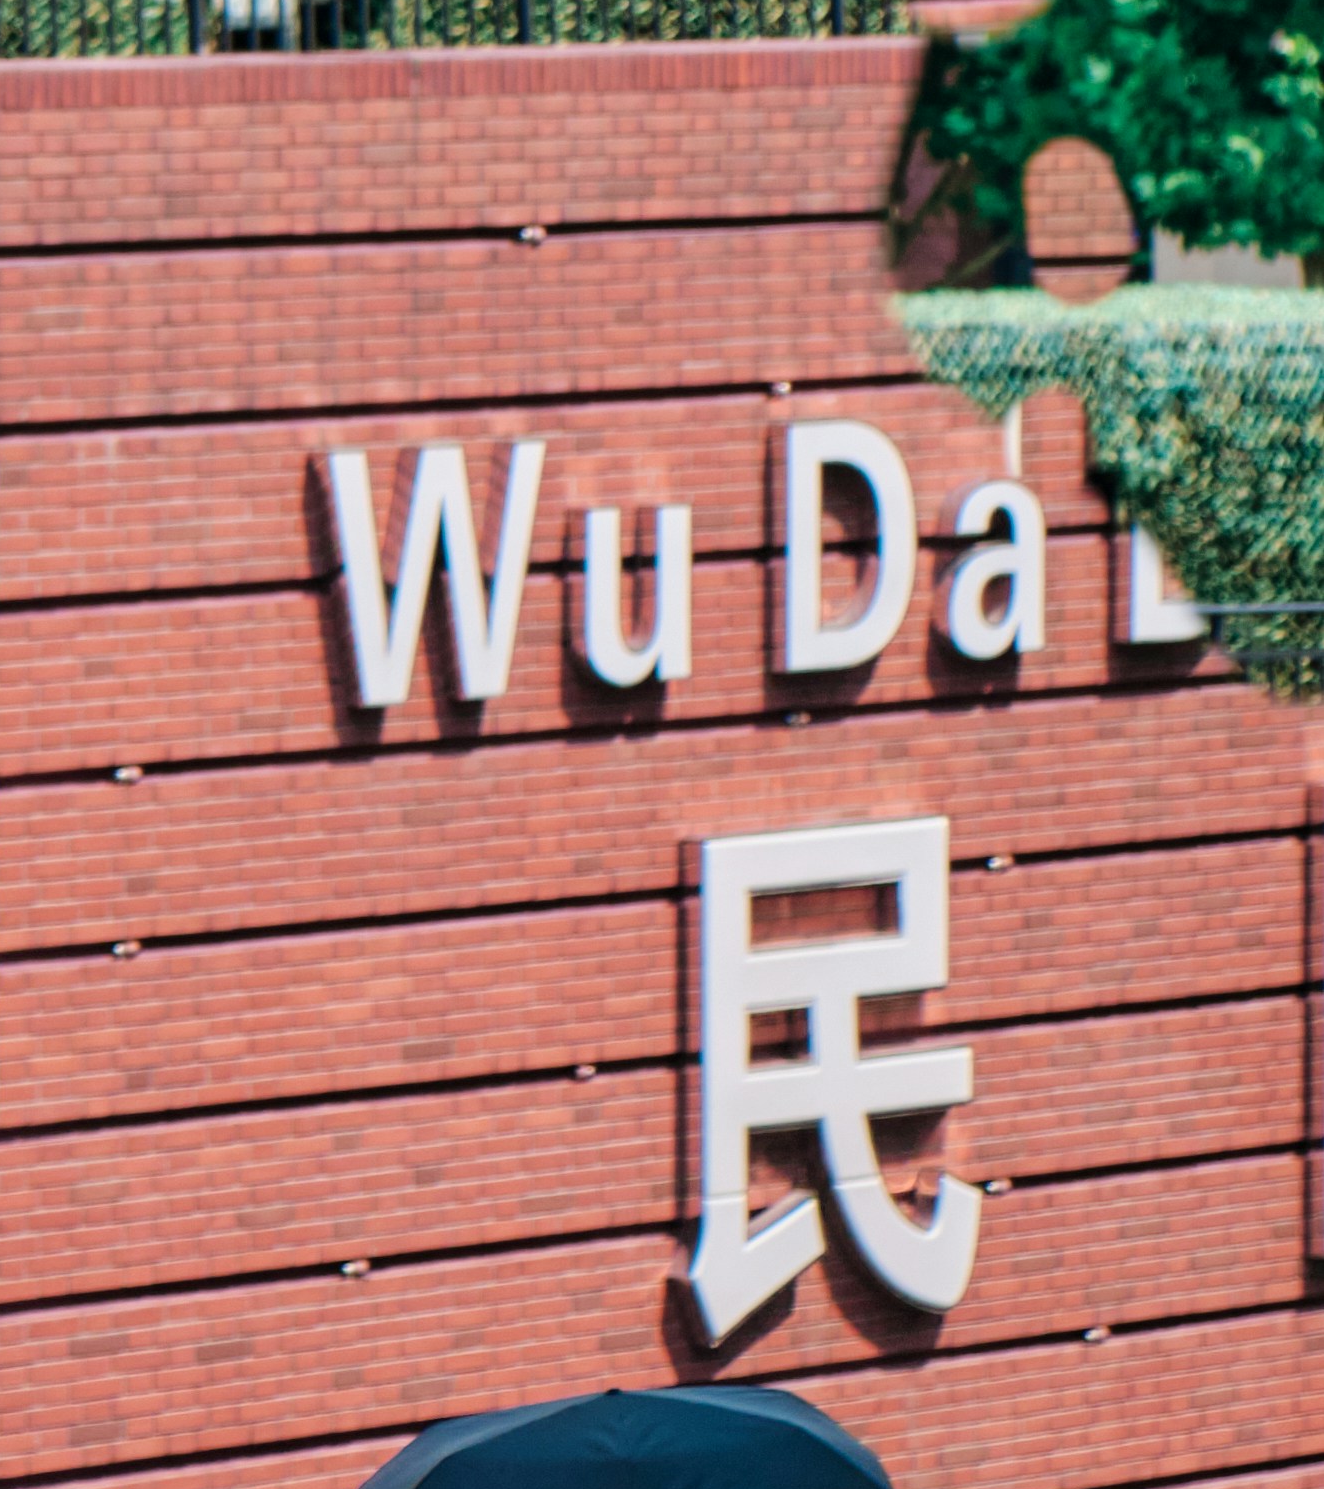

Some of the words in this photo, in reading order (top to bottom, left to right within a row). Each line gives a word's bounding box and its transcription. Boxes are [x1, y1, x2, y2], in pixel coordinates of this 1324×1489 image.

[329, 439, 693, 709] Wu
[783, 420, 1045, 674] Da
[689, 815, 983, 1347] 民
